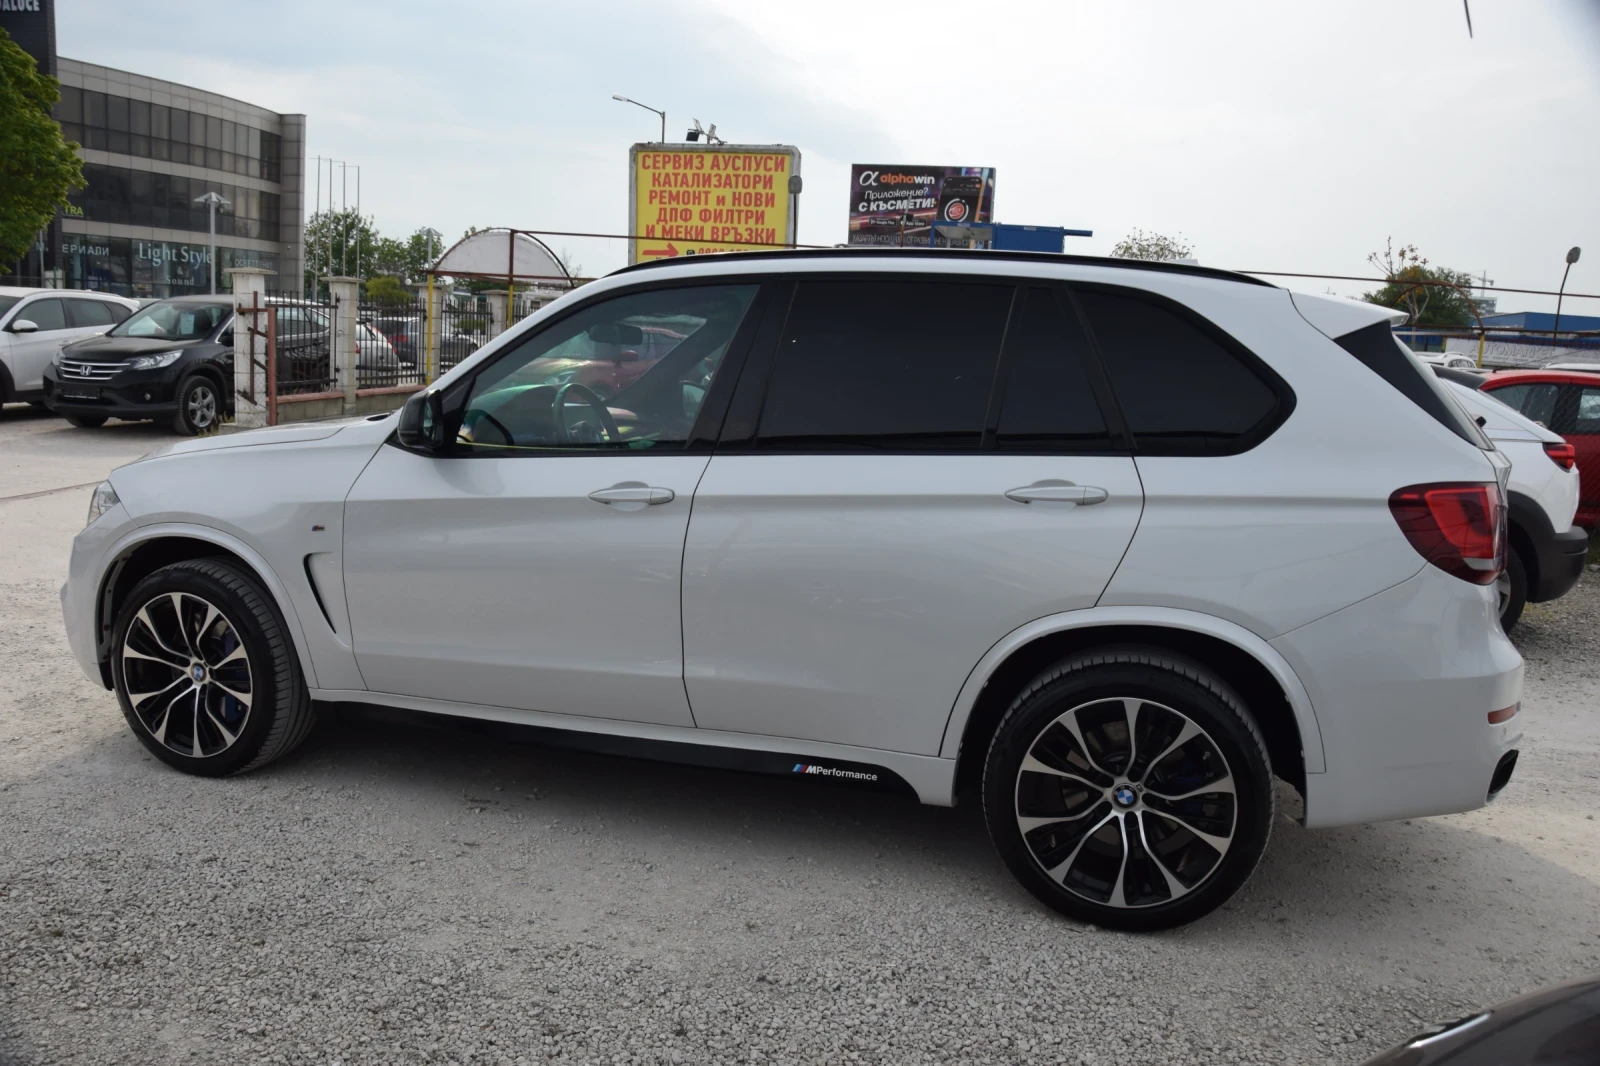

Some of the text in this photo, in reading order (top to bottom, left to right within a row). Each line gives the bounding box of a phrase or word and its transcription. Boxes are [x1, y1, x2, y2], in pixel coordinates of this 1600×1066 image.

[0, 0, 40, 11] ALUCE
[641, 154, 785, 172] СЕРВИЗ АУСПУСИ
[652, 172, 773, 190] КАТАЛИЗАТОРИ
[880, 173, 935, 186] alphawin
[649, 190, 711, 206] РЕМОНТ
[732, 192, 775, 208] НОВИ
[864, 187, 929, 200] Приложение?
[870, 198, 936, 212] КЪСМЕТИ!
[656, 207, 765, 226] ДПФ ФИЛТРИ
[645, 224, 776, 245] И МЕКИ ВРЪЗКИ
[139, 242, 212, 269] Light Style
[177, 266, 184, 275] &
[166, 275, 195, 286] Sound
